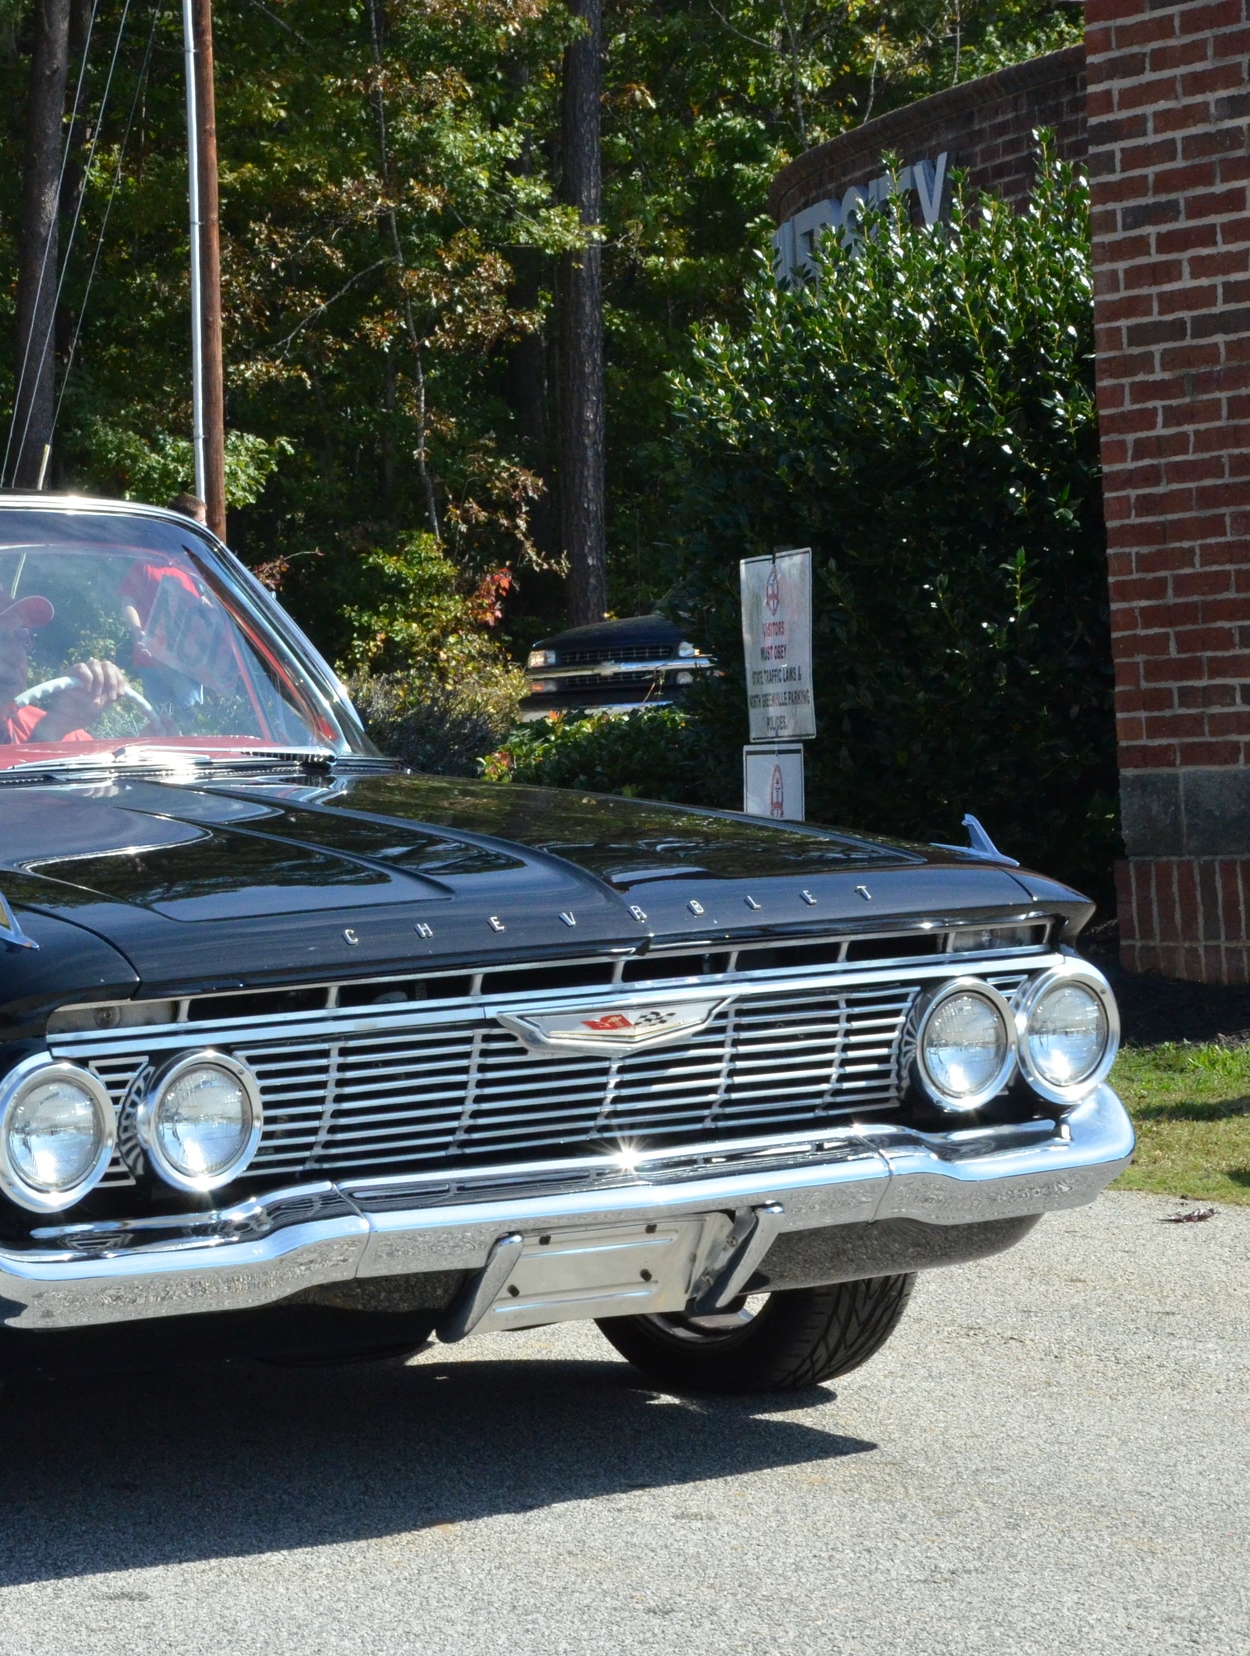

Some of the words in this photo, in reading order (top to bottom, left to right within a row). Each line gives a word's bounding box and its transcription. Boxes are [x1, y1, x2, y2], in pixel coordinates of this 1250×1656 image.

[763, 621, 784, 637] VISITORS
[761, 646, 773, 660] MUST
[774, 644, 787, 659] OBEY
[752, 670, 764, 686] STATE
[764, 668, 782, 685] TRAFFIC
[783, 666, 797, 683] LAWS
[762, 691, 787, 707] GREENVILLE
[788, 688, 810, 705] PARKING
[341, 885, 873, 946] CHEVROLET
